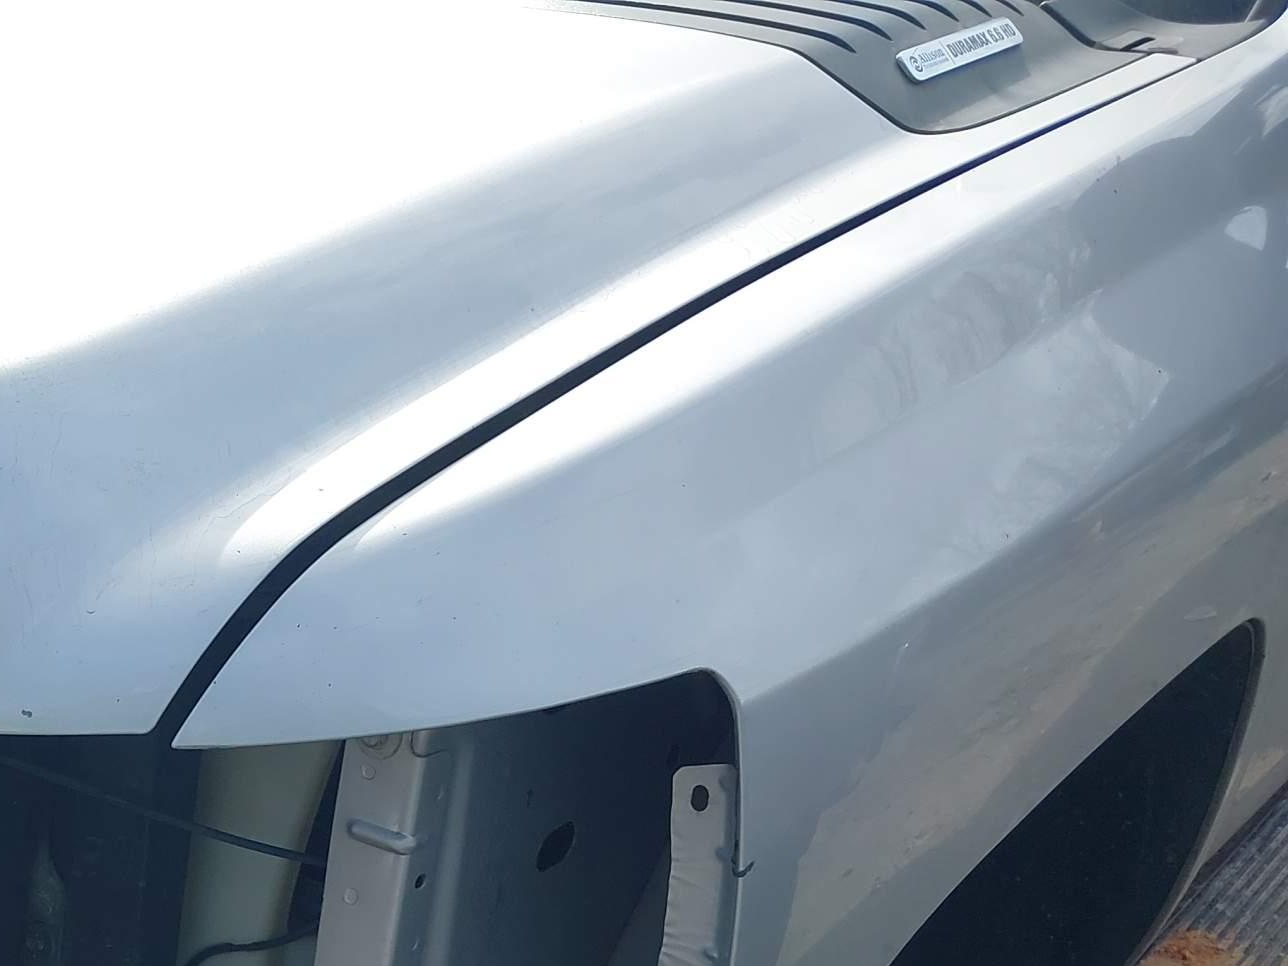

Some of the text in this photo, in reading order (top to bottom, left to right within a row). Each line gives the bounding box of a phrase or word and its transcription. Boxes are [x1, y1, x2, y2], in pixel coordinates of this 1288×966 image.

[946, 23, 1016, 58] DURAMAX 6.6 HD
